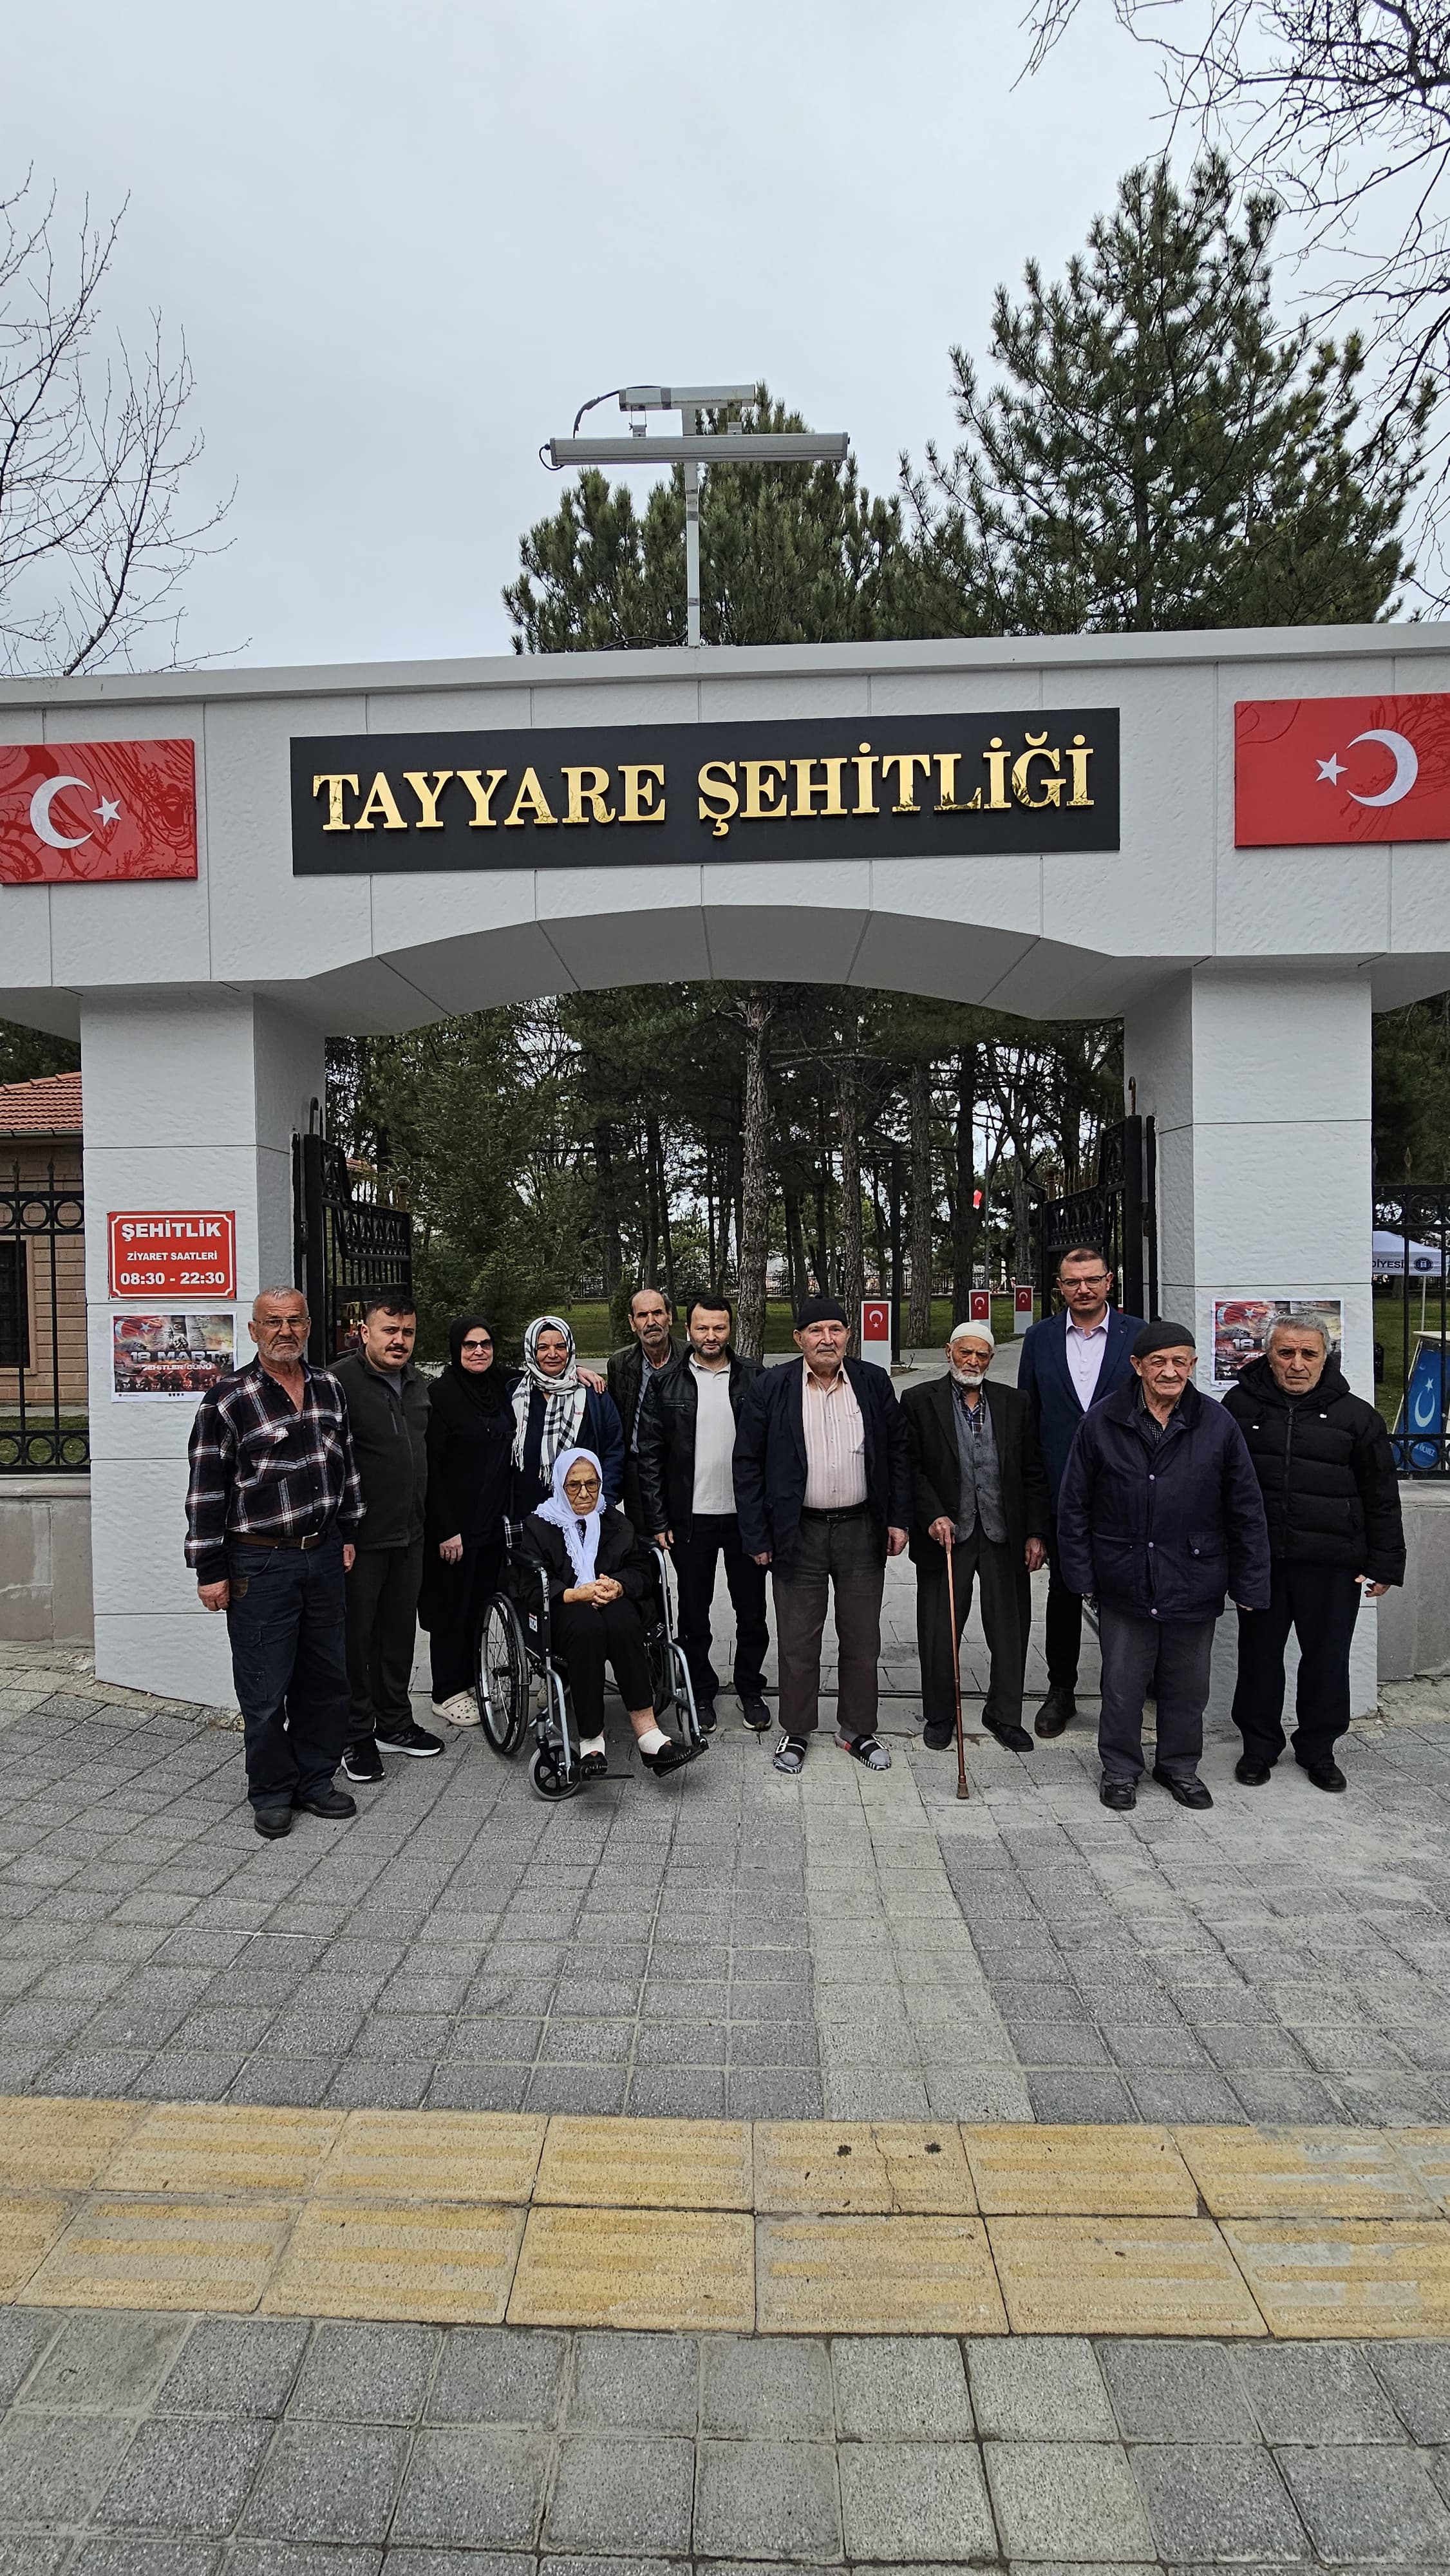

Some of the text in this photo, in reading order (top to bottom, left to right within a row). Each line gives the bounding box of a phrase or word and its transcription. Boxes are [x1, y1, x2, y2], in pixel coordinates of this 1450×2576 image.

[313, 731, 1095, 838] TAYYARE ŞEHİTLİĞİ
[121, 1219, 221, 1242] ŞEHİTLİK
[127, 1250, 218, 1261] ZİYARET SAATLERİ
[120, 1273, 165, 1285] 08:30
[180, 1272, 225, 1284] 22:30
[1232, 1339, 1254, 1351] 18
[131, 1351, 219, 1363] 18 MART
